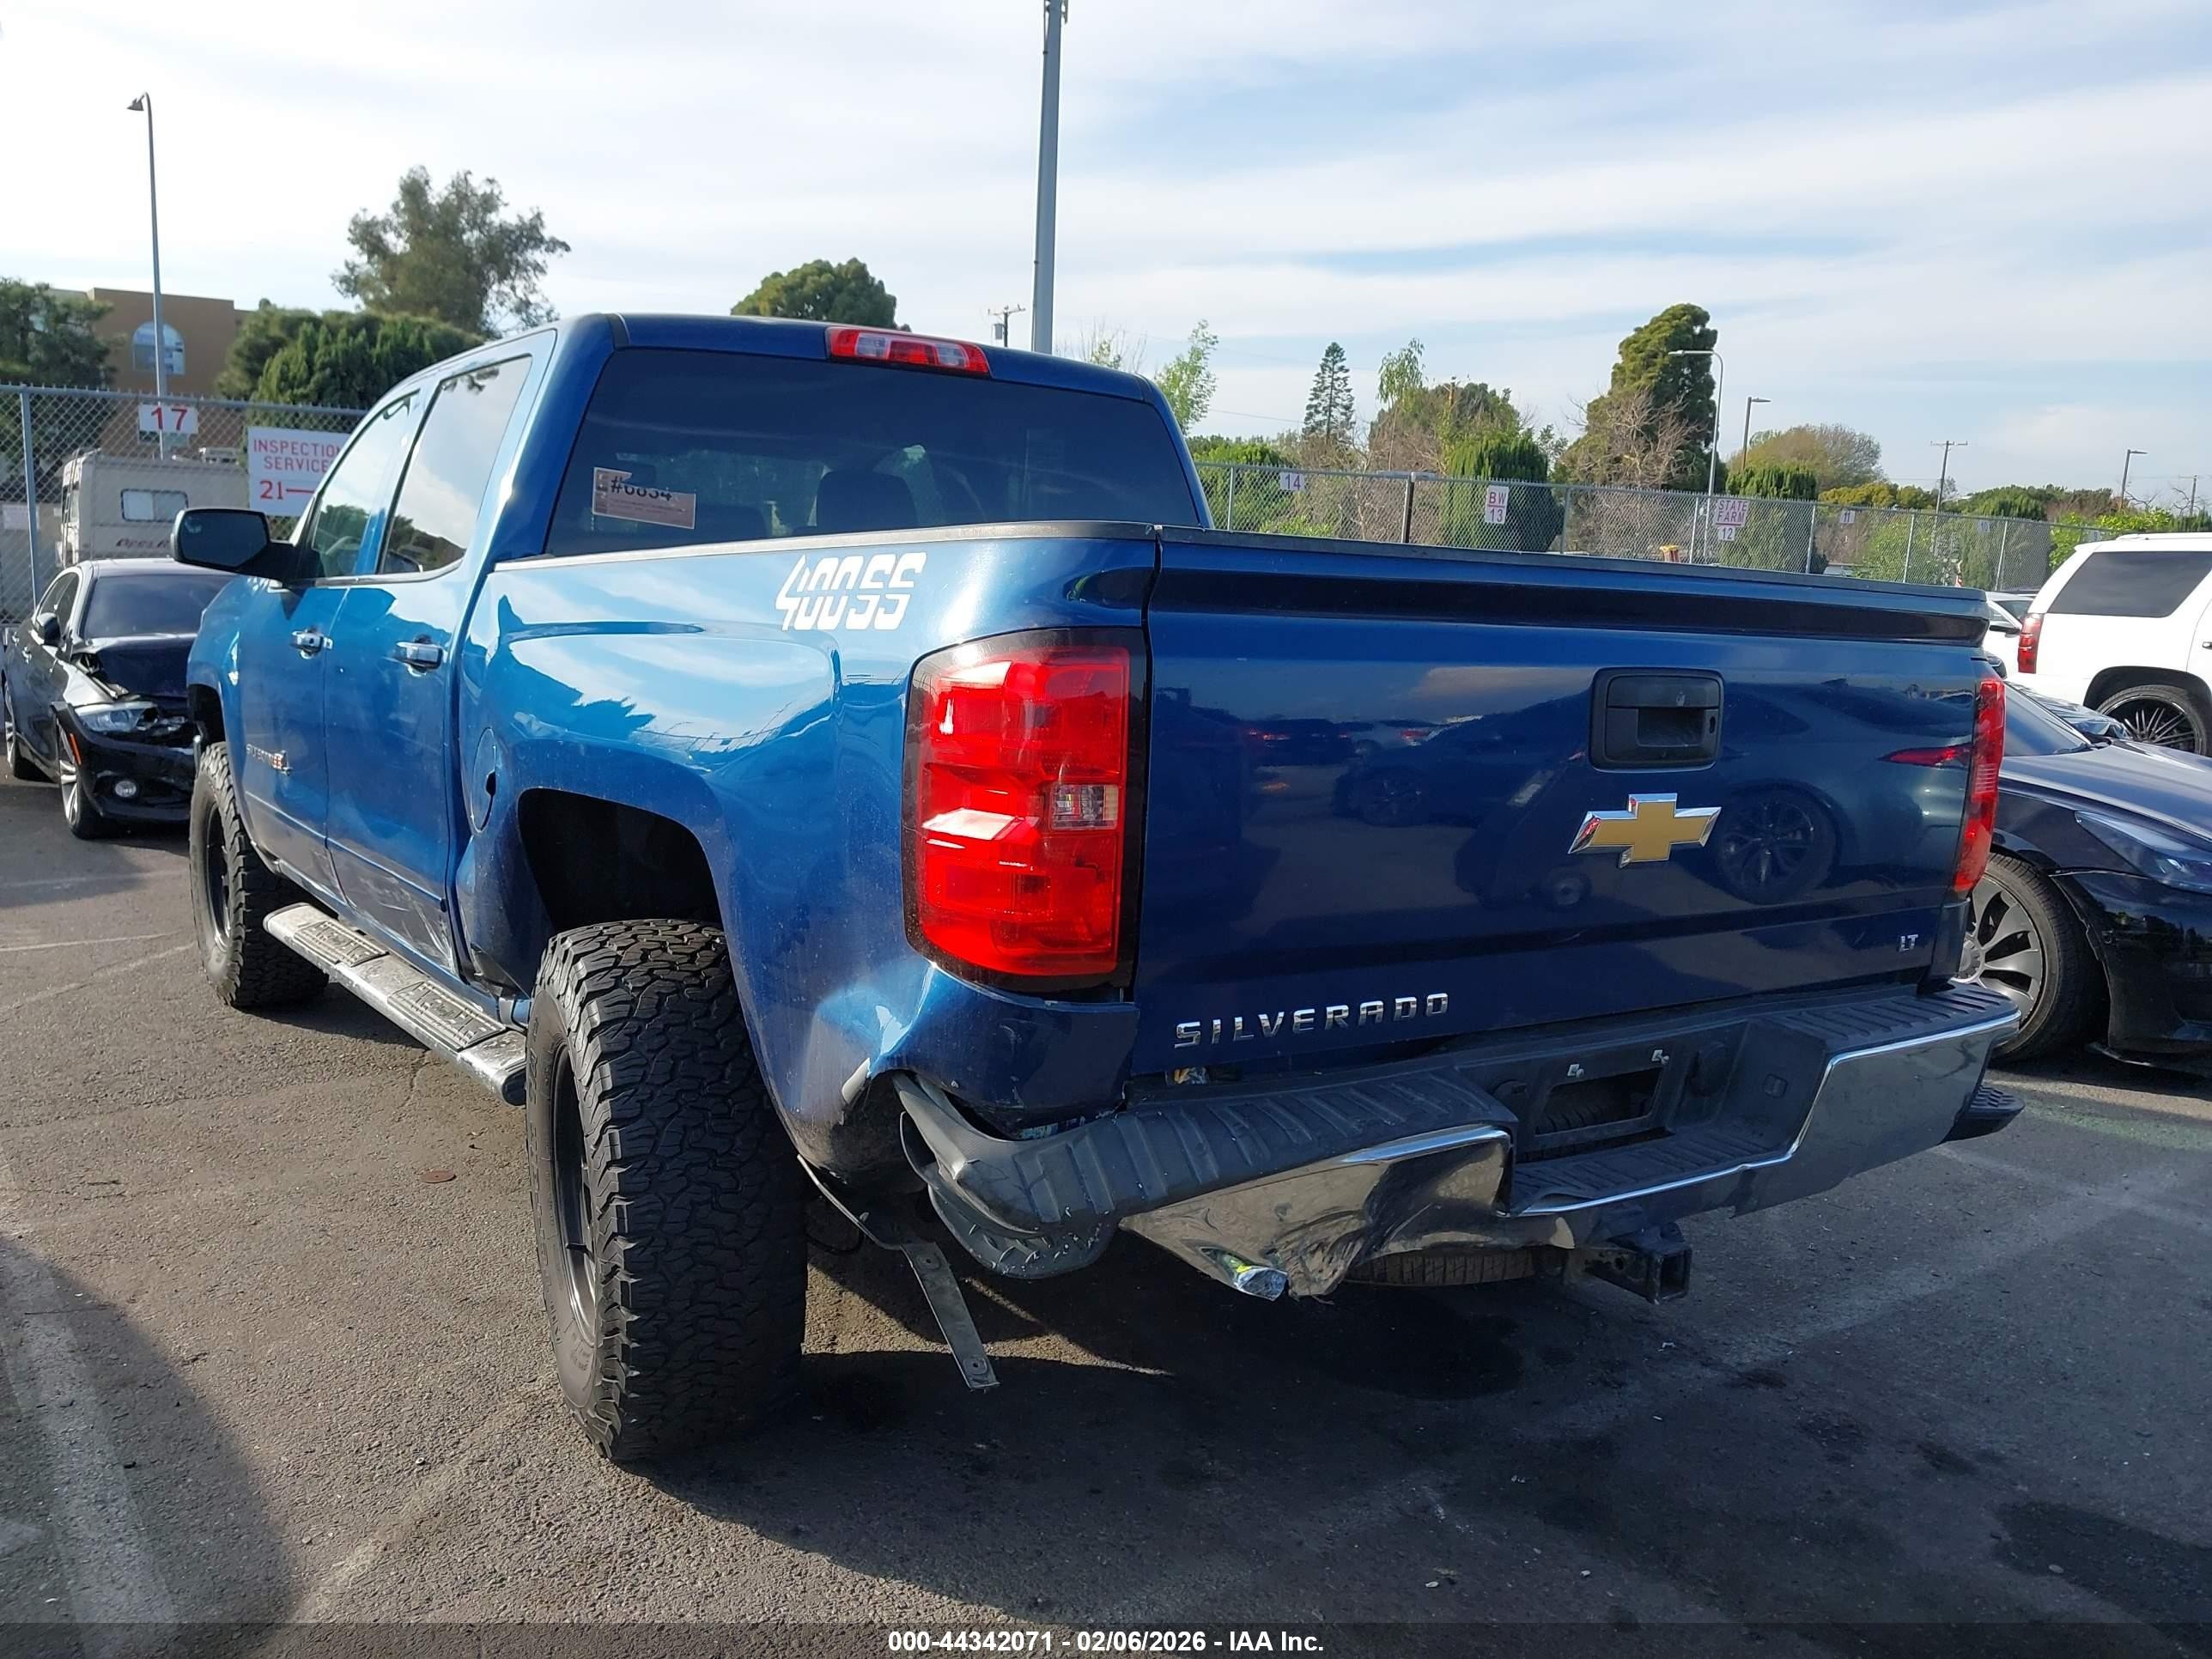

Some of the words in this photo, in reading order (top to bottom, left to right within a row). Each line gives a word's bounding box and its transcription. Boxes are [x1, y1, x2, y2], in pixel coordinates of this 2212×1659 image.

[151, 406, 188, 431] 17
[264, 456, 334, 473] SERVICE
[259, 480, 284, 501] 21
[1285, 473, 1302, 491] 14
[1489, 491, 1507, 505] BW
[1718, 500, 1748, 512] STATE
[1490, 508, 1504, 523] 13
[1717, 511, 1745, 523] FARM
[1723, 527, 1734, 540] 12
[1899, 933, 1919, 952] LT
[1174, 993, 1449, 1049] SILVERADO
